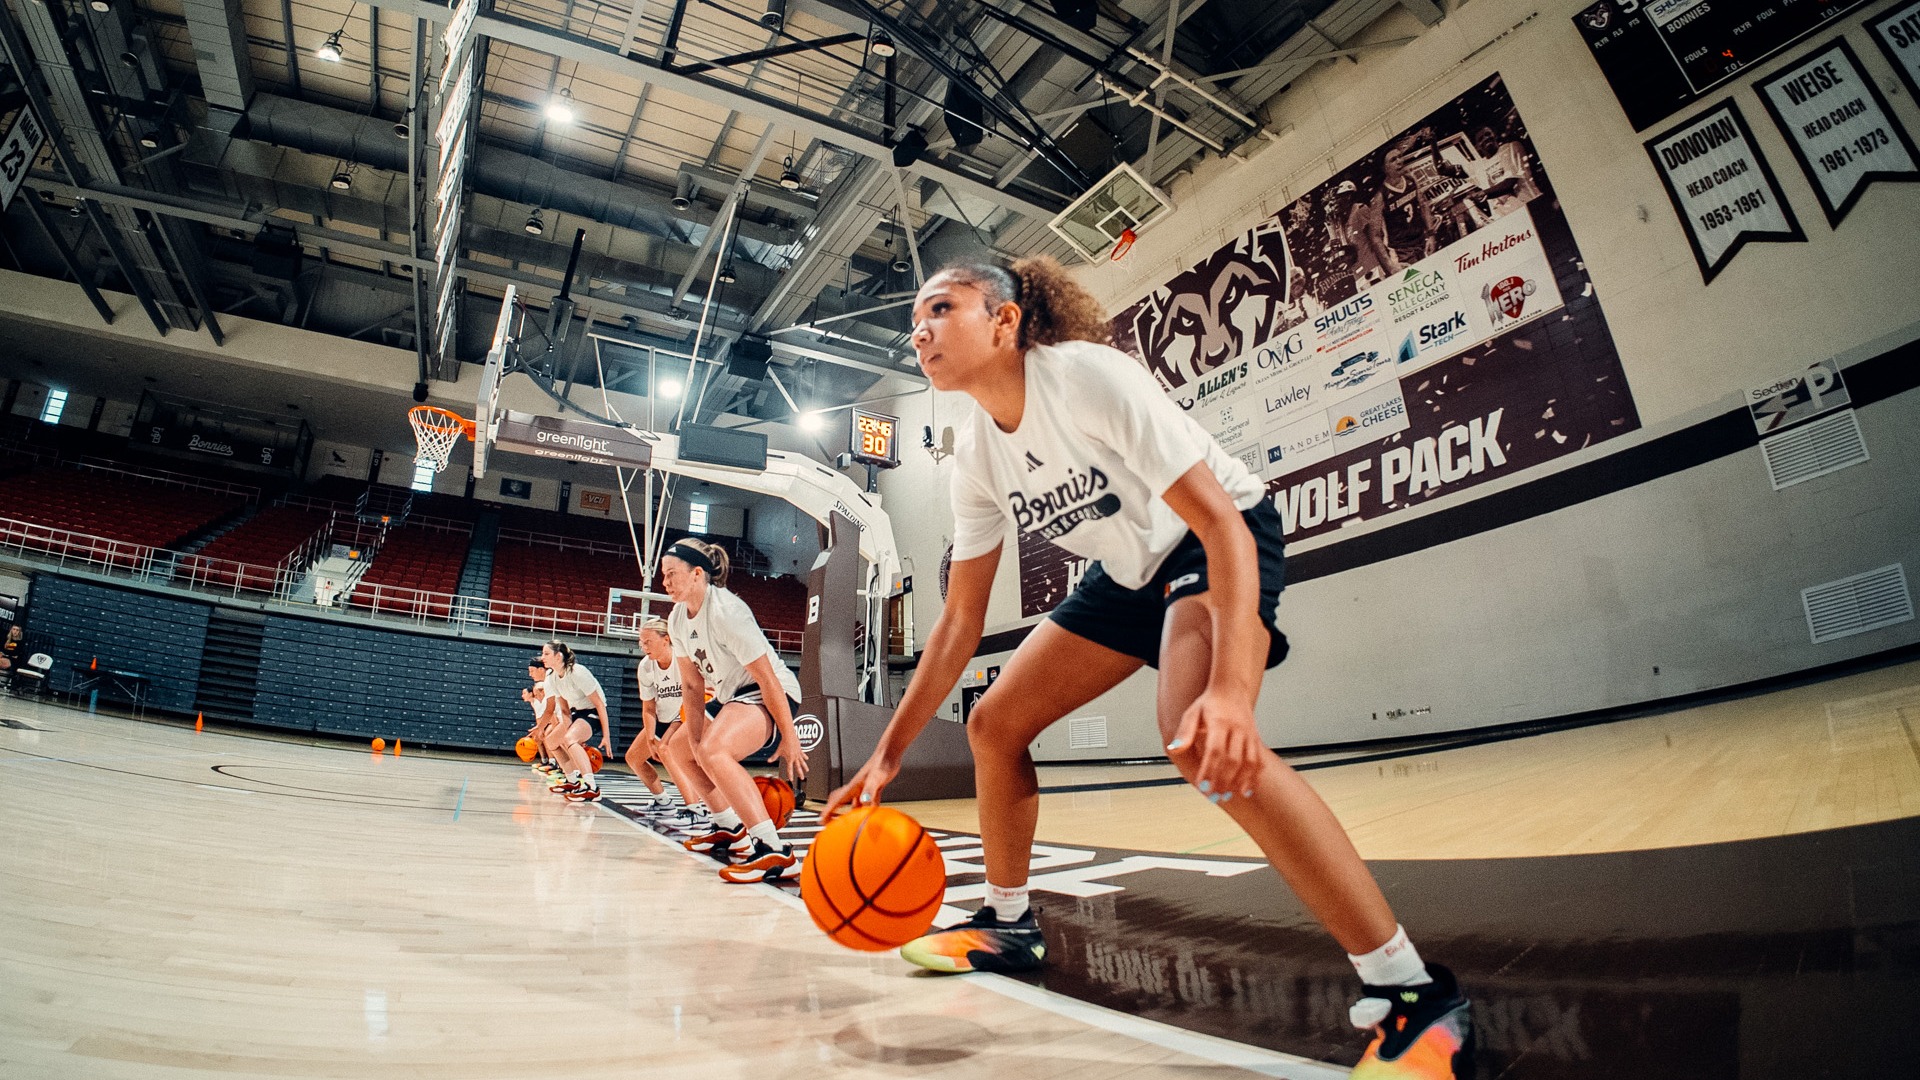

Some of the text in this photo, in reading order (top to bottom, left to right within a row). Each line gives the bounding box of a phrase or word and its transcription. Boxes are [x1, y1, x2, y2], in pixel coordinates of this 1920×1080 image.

[1666, 3, 1711, 34] BONNIES
[1732, 21, 1752, 36] PLYR
[1756, 8, 1777, 22] FOUL
[1887, 10, 1920, 49] SAT
[1683, 46, 1708, 64] FOULS
[1780, 60, 1843, 106] WEISE
[1802, 97, 1867, 139] HEAD COACH
[0, 138, 26, 183] 23
[1660, 116, 1738, 171] DONOVAN
[1818, 128, 1889, 174] 1961-1973
[1686, 158, 1749, 198] HEAD COACH
[1699, 188, 1766, 231] 1953-1961
[1454, 228, 1532, 273] Tim Hortons
[1387, 270, 1443, 306] SENECA
[1392, 282, 1446, 316] ALLEGANY
[1314, 292, 1373, 333] SHULTS
[1394, 308, 1418, 324] RESORT
[1425, 293, 1450, 309] CASINO
[1419, 310, 1466, 345] Stark
[1434, 334, 1455, 348] TECH
[1257, 332, 1303, 370] OMG
[1196, 361, 1248, 401] ALLEN'S
[1752, 364, 1835, 410] Section P
[1265, 385, 1311, 413] Lawley
[1360, 396, 1403, 418] GREAT LAKES
[1362, 403, 1405, 429] CHEESE
[536, 431, 608, 451] greenlight
[1226, 418, 1251, 434] General
[188, 434, 233, 455] Bonnies
[863, 433, 886, 455] 30
[1274, 408, 1508, 535] WOLF PACK
[588, 495, 605, 504] VCU
[1008, 466, 1109, 529] Bonnies
[833, 500, 867, 532] SPALDING
[807, 594, 820, 625] B
